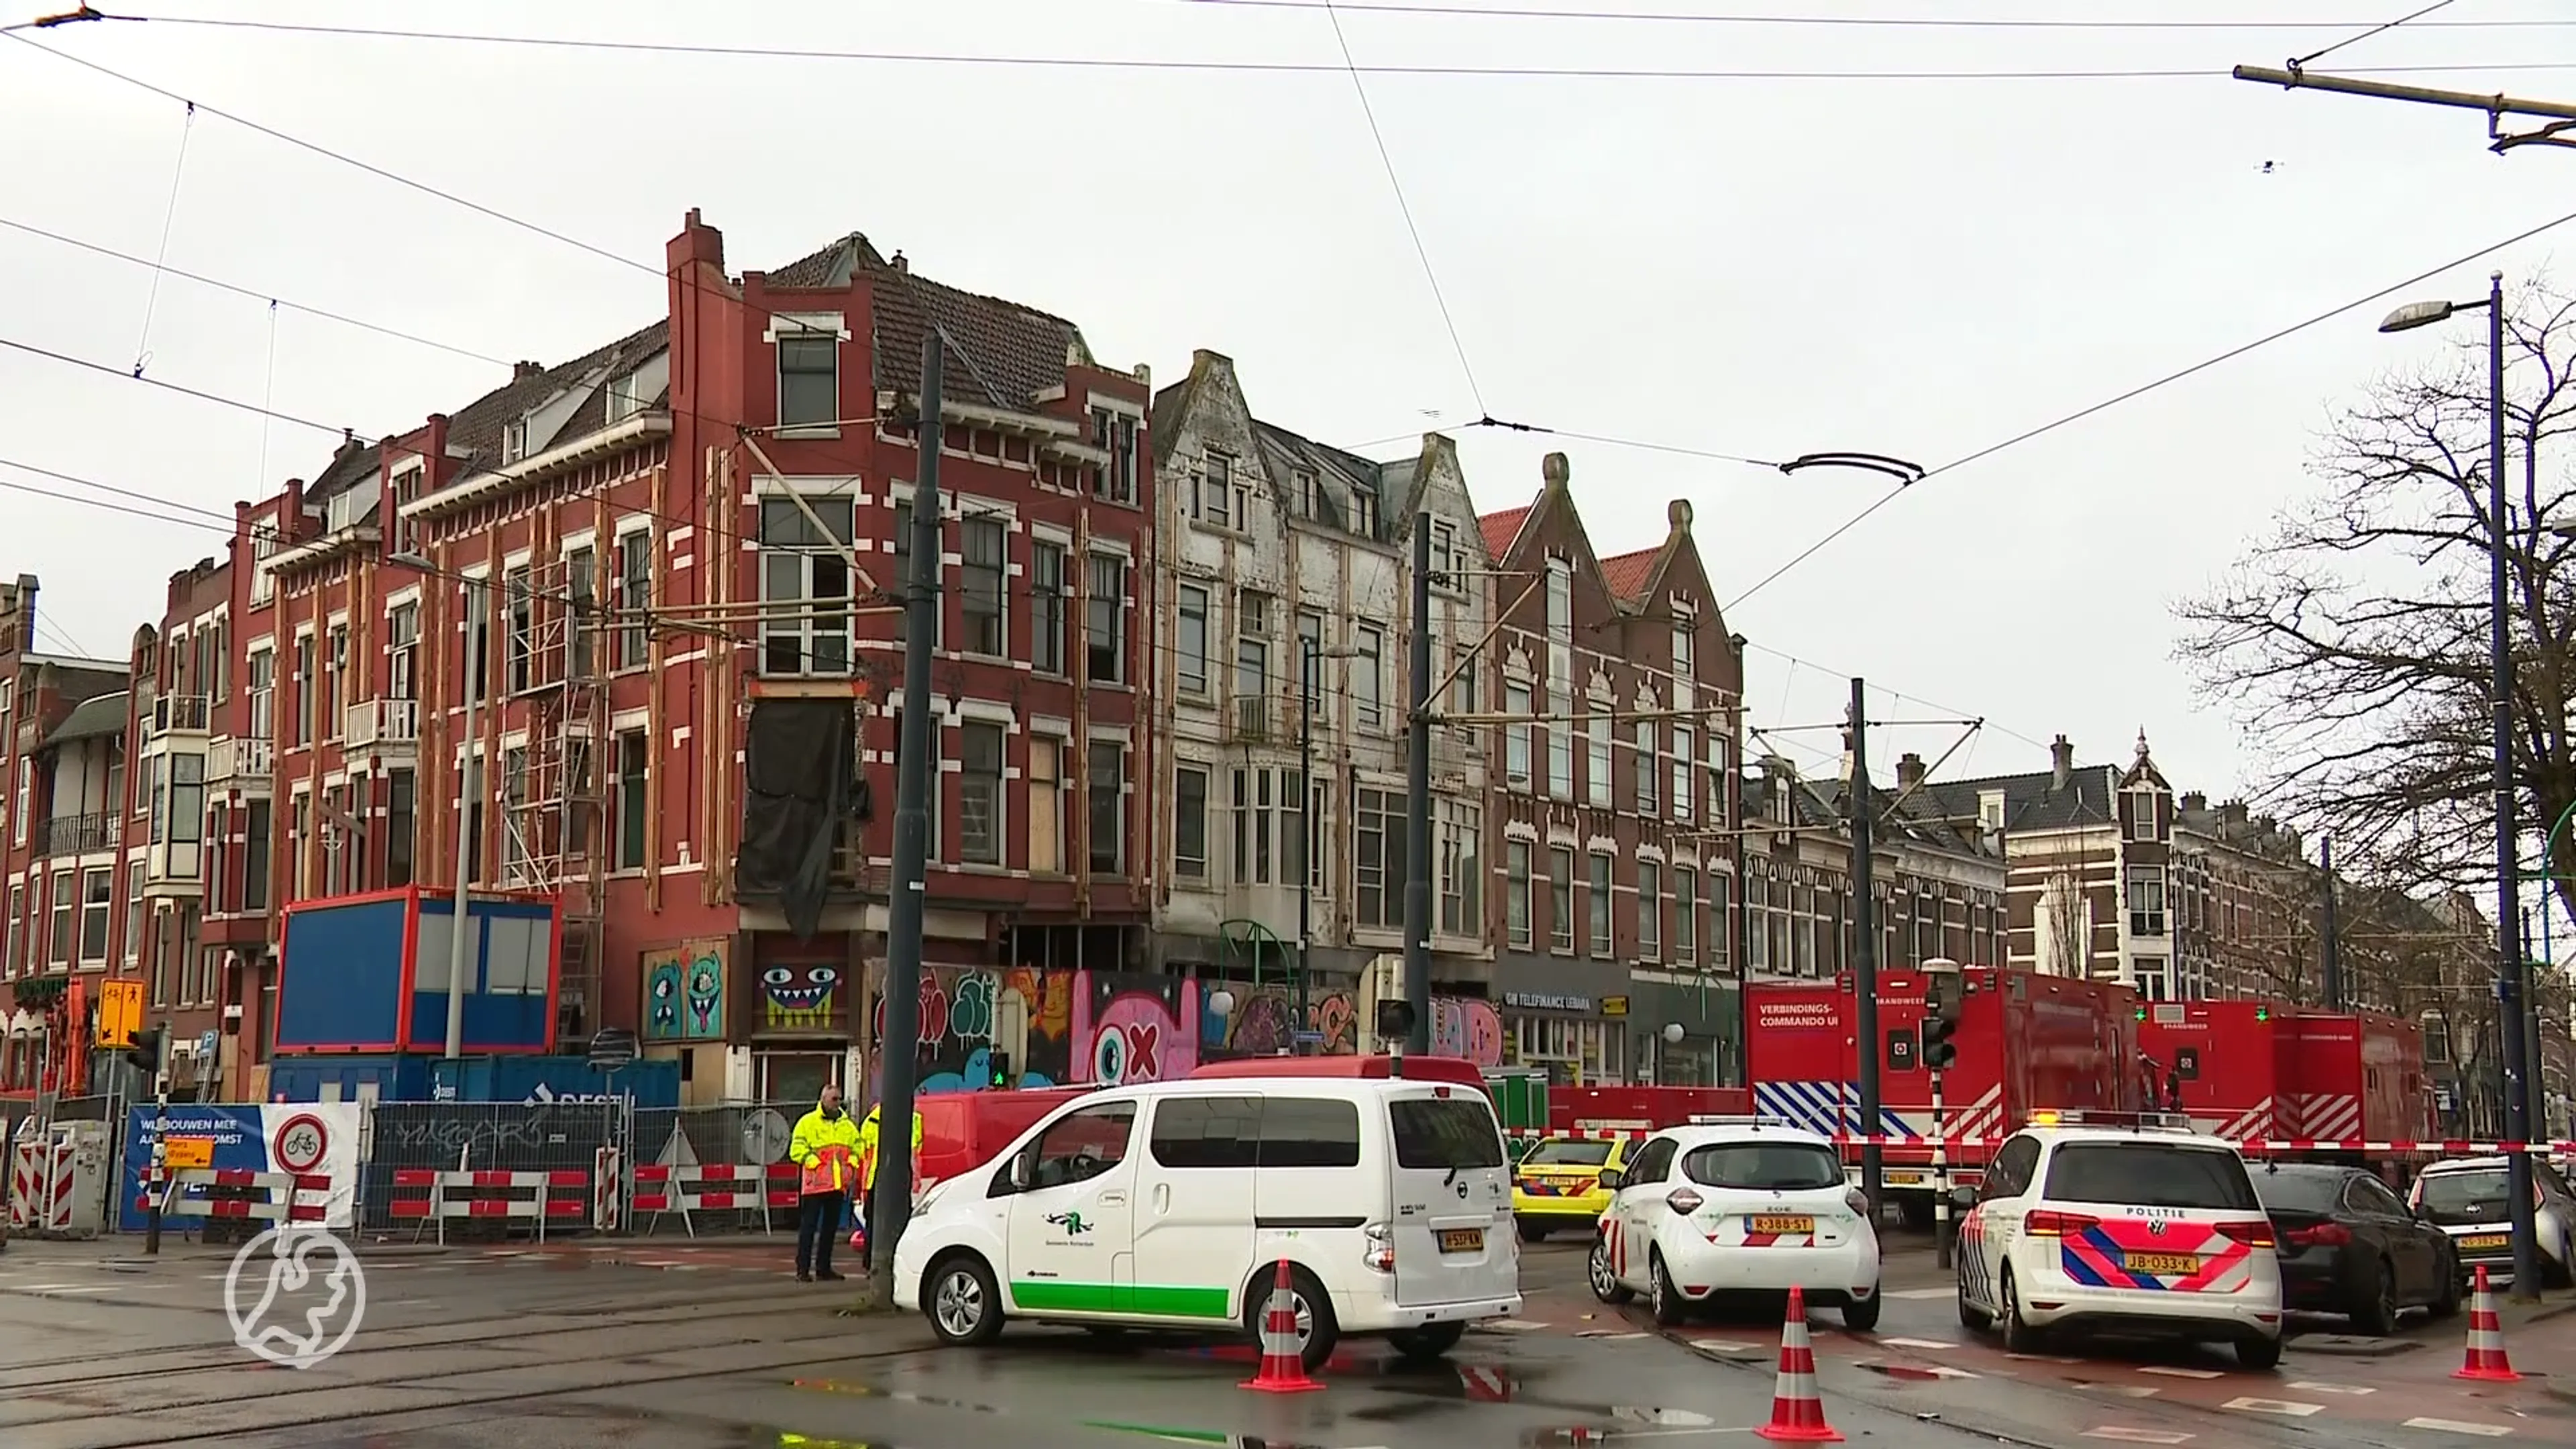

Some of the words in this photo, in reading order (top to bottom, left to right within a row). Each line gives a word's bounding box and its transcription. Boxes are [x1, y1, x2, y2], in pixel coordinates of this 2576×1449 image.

[1760, 1004, 1833, 1014] VERBINDINGS-
[1760, 1016, 1825, 1026] COMMANDO
[140, 1134, 156, 1144] AA
[2127, 1208, 2185, 1218] POLITIE
